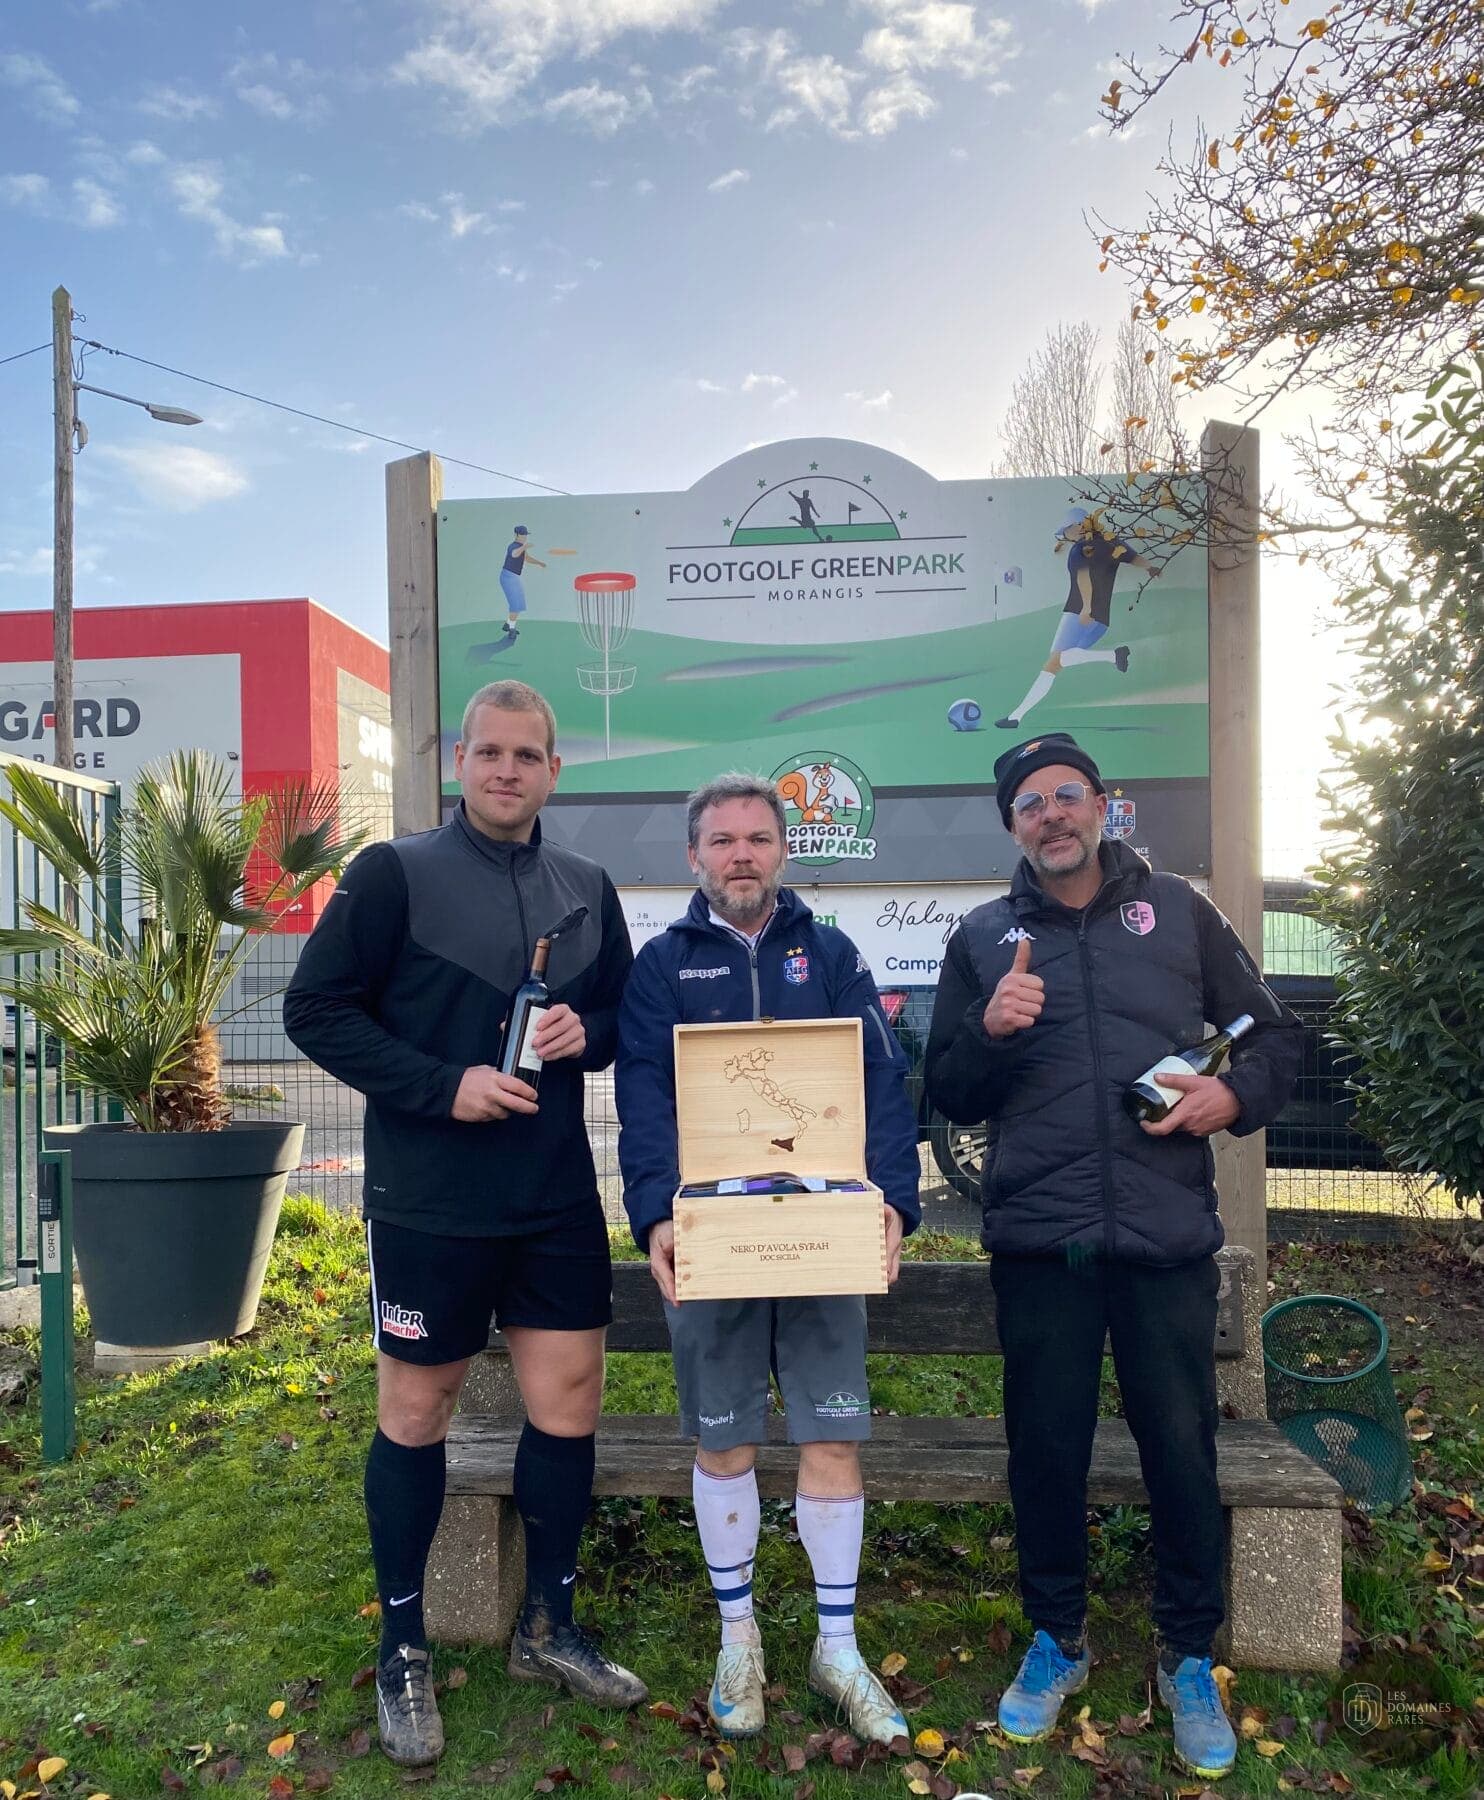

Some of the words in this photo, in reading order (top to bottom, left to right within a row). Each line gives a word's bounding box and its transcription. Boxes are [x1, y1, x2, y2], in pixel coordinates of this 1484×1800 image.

[669, 559, 804, 584] FOOTGOLF
[811, 552, 966, 579] GREENPARK
[768, 587, 864, 602] MORANGIS
[1105, 815, 1134, 826] AFFG
[679, 966, 731, 979] Kappa
[48, 1223, 56, 1259] SORTIE
[730, 1244, 756, 1254] NERO
[798, 1242, 830, 1252] SYRAH
